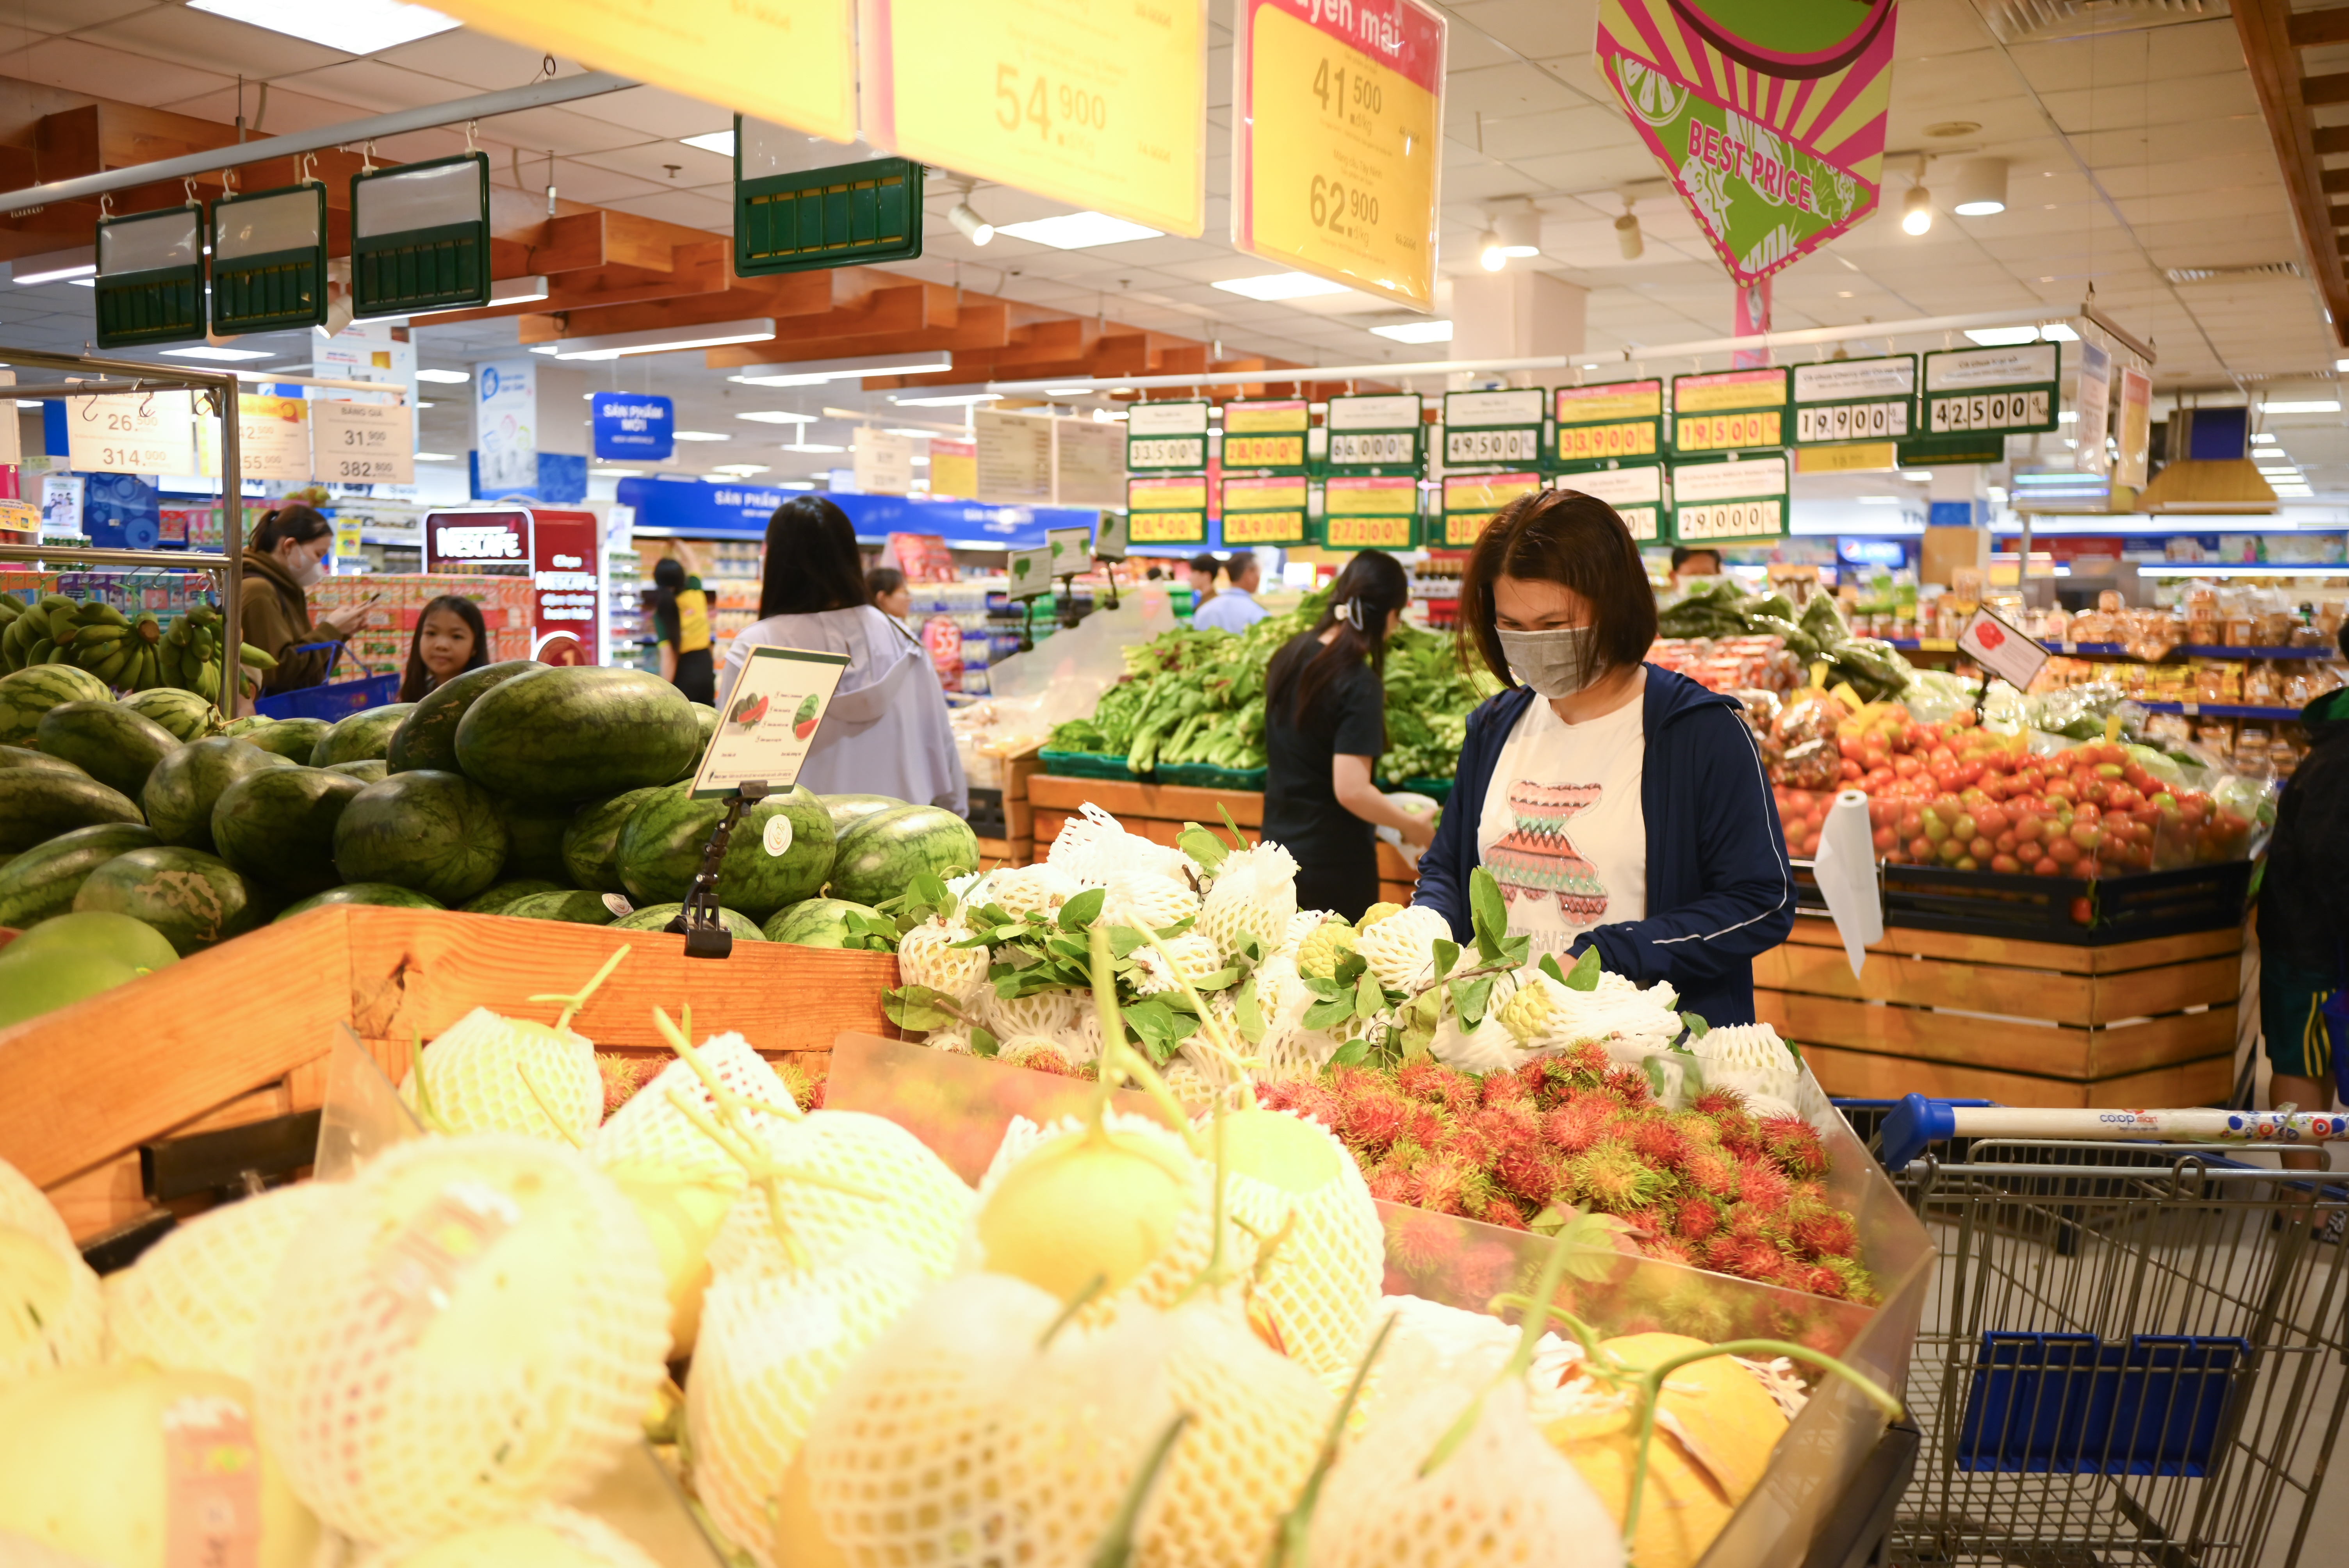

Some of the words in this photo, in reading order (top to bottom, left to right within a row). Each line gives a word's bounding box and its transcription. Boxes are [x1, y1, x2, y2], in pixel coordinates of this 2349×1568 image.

[1361, 8, 1400, 57] mãi
[1688, 117, 1747, 179] BEST
[1751, 150, 1812, 213] PRICE
